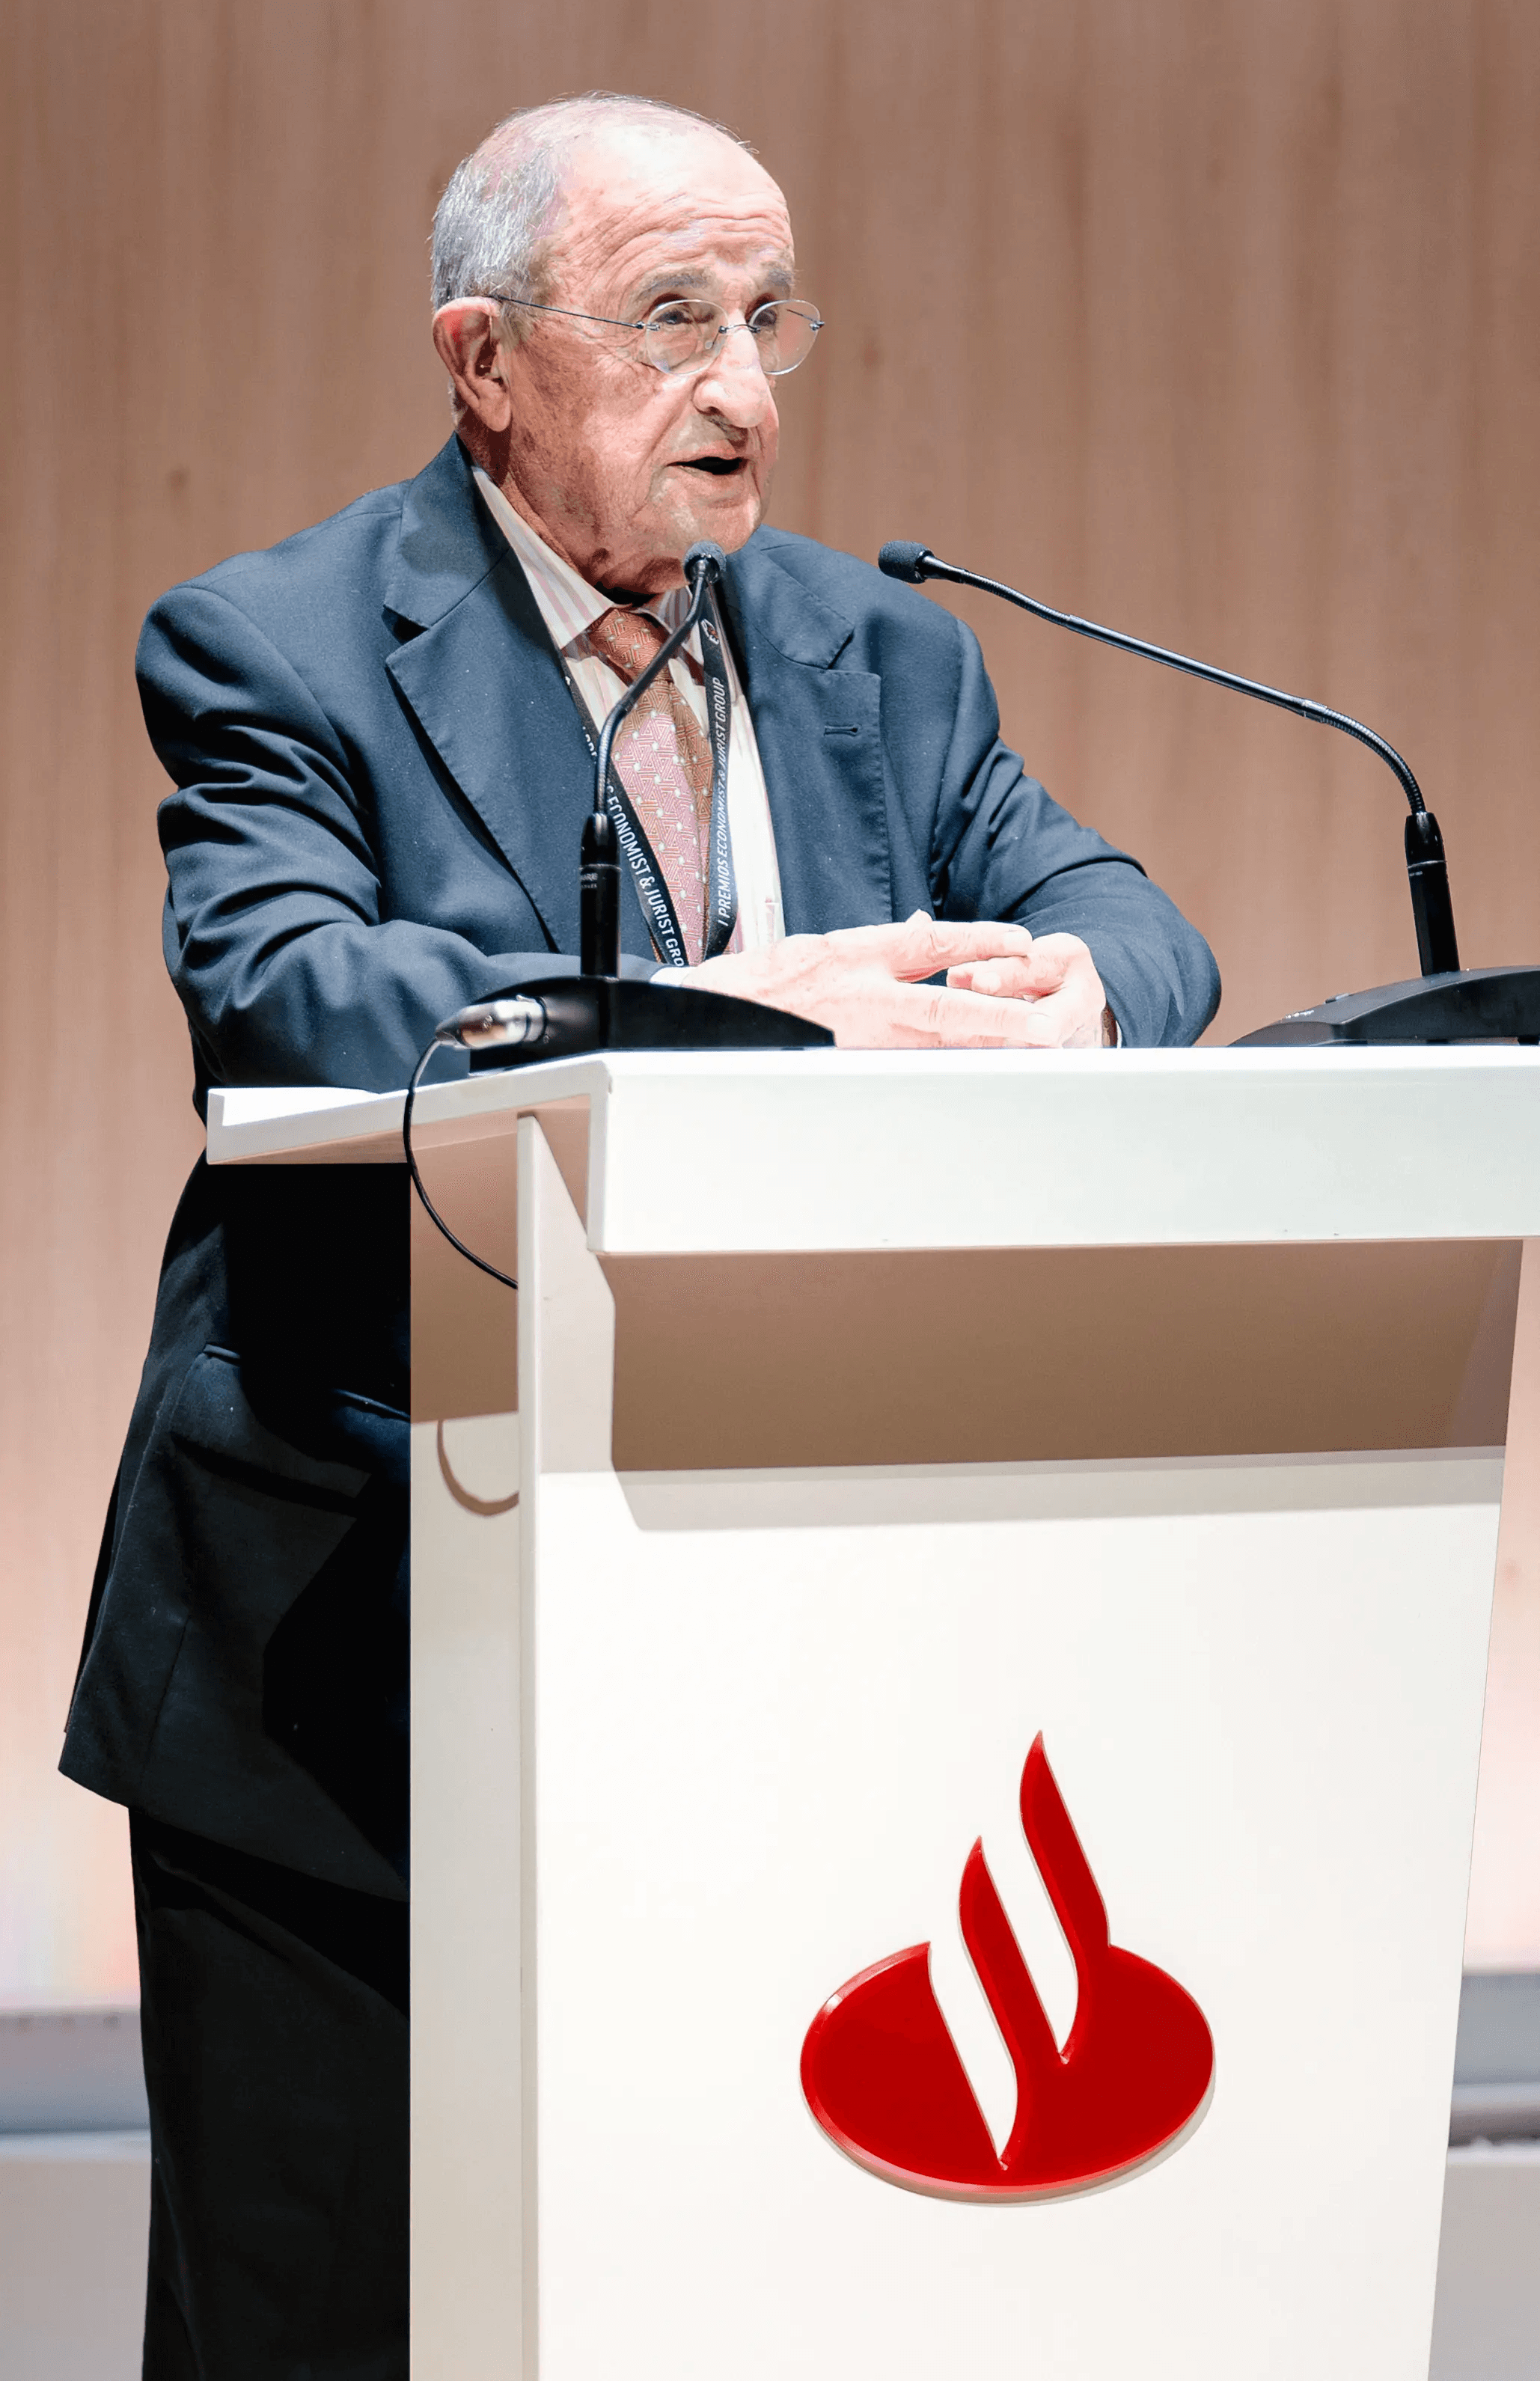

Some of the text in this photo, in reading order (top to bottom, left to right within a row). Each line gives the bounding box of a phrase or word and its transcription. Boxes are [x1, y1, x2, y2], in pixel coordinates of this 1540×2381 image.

[712, 676, 726, 723] GROUP
[715, 722, 727, 771] JURIST
[718, 769, 726, 780] &
[716, 779, 728, 858] ECONOMIST
[639, 876, 656, 888] &
[717, 857, 731, 919] PREMIOS
[644, 888, 675, 935] JURIST
[665, 938, 685, 967] GRO
